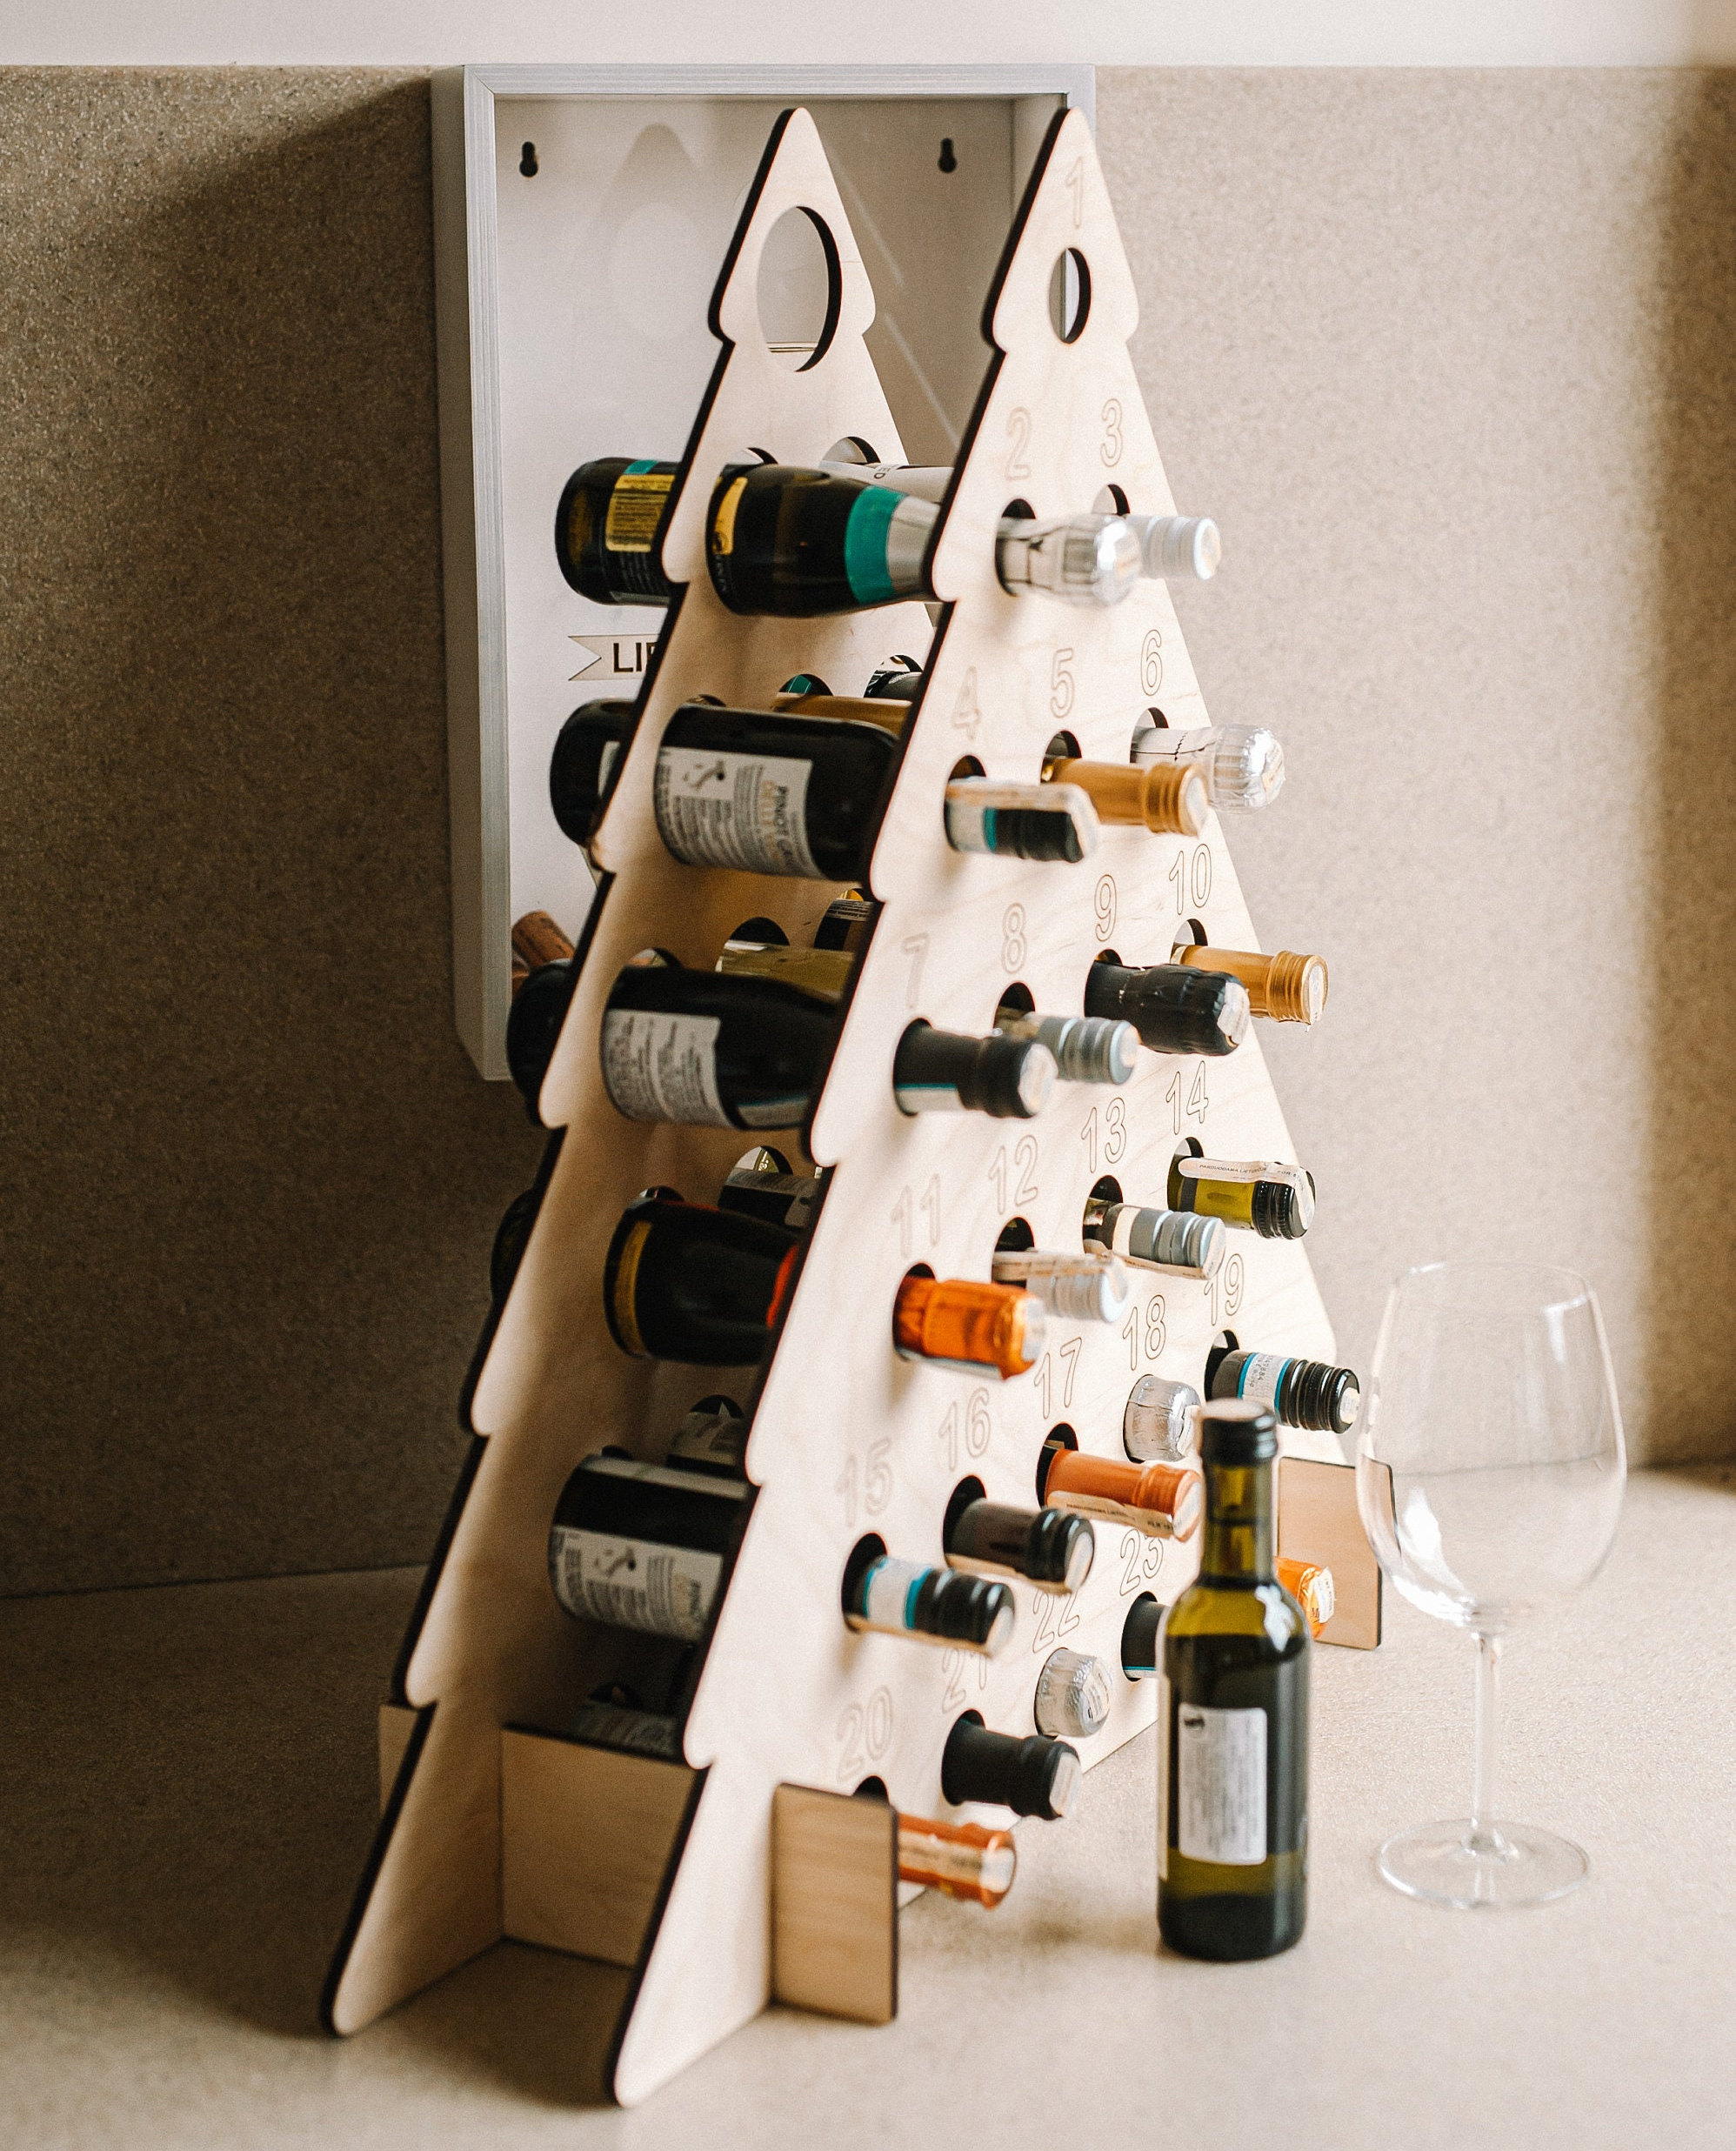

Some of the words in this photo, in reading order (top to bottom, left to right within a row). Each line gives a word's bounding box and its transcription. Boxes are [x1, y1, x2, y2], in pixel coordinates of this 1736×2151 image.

[1066, 157, 1084, 230] 1
[1006, 407, 1032, 481] 2
[1100, 398, 1124, 467] 3
[1051, 648, 1074, 718] 5
[1140, 629, 1162, 696] 6
[953, 667, 979, 740] 4
[1095, 874, 1118, 942] 9
[1169, 843, 1212, 915] 10
[903, 933, 929, 1010] 7
[1002, 902, 1027, 974] 8
[1167, 1060, 1209, 1135] 14
[1081, 1097, 1126, 1173] 13
[990, 1134, 1038, 1214] 12
[892, 1173, 941, 1258] 11
[1205, 1253, 1244, 1326] 19
[1124, 1294, 1166, 1371] 18
[1035, 1337, 1083, 1420] 17
[939, 1387, 992, 1471] 16
[838, 1439, 893, 1528] 15
[1119, 1528, 1165, 1595] 23
[1033, 1593, 1081, 1653] 22
[837, 1687, 893, 1780] 20
